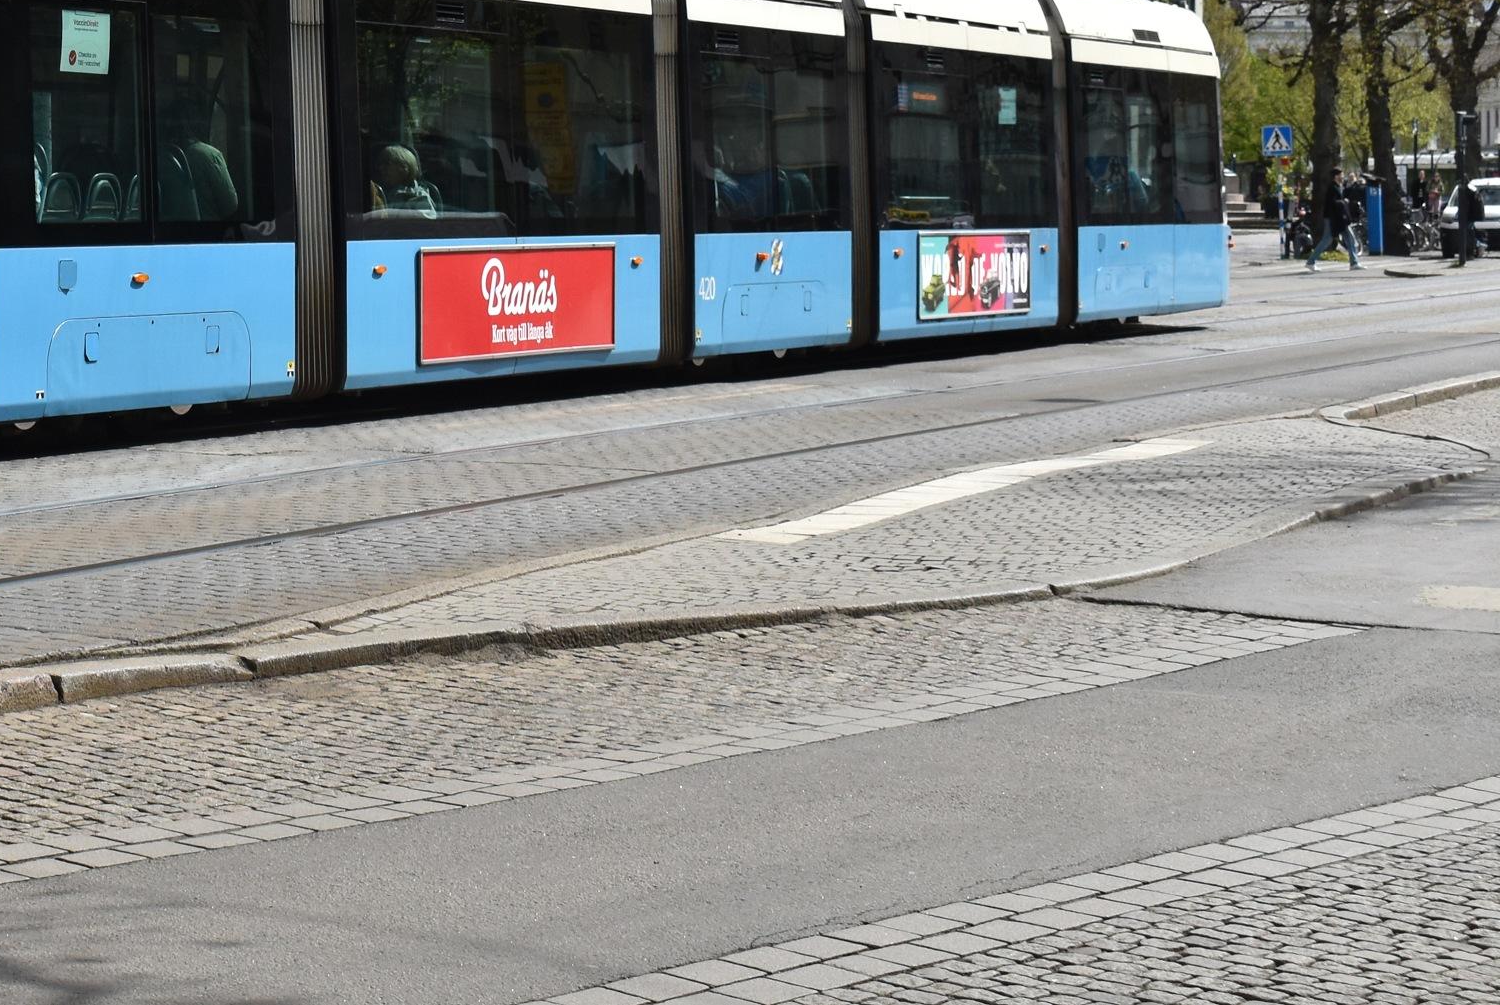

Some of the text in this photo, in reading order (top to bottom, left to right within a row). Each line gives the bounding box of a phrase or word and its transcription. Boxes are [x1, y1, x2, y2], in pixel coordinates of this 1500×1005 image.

[481, 258, 558, 316] Branäs
[699, 276, 716, 300] 420
[990, 252, 1028, 294] VOLVO
[492, 320, 554, 345] Kort väg till långa åk
